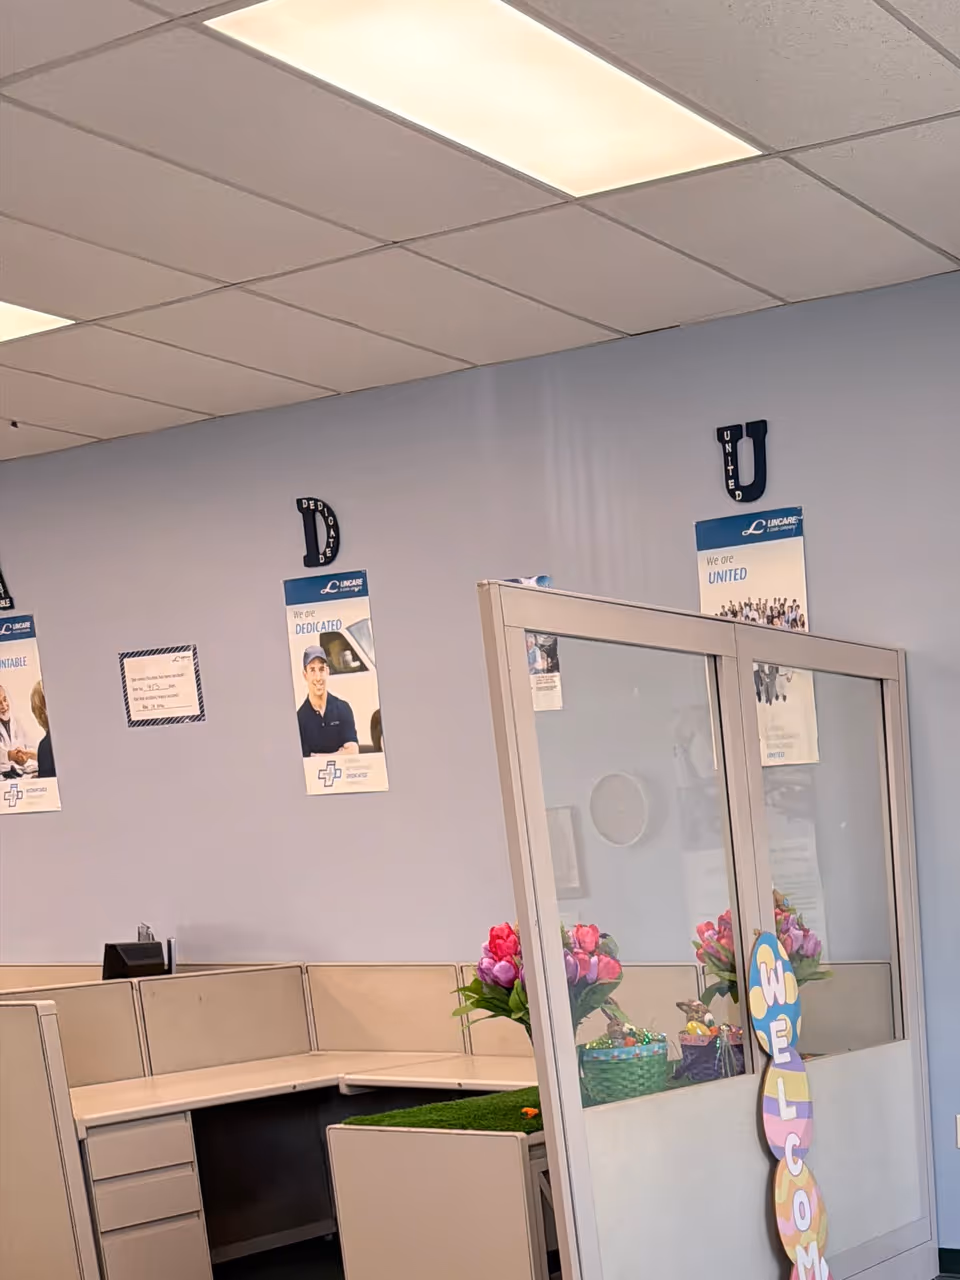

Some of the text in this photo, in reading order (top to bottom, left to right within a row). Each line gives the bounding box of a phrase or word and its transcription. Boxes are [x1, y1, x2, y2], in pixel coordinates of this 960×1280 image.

[724, 430, 743, 500] UNITED
[767, 516, 797, 527] LINCARE
[302, 500, 336, 563] DEDICATED
[706, 555, 734, 566] We are
[708, 567, 748, 584] UNITED
[340, 578, 363, 588] LINCARE
[293, 609, 316, 619] We are
[295, 619, 343, 635] DEDICATED
